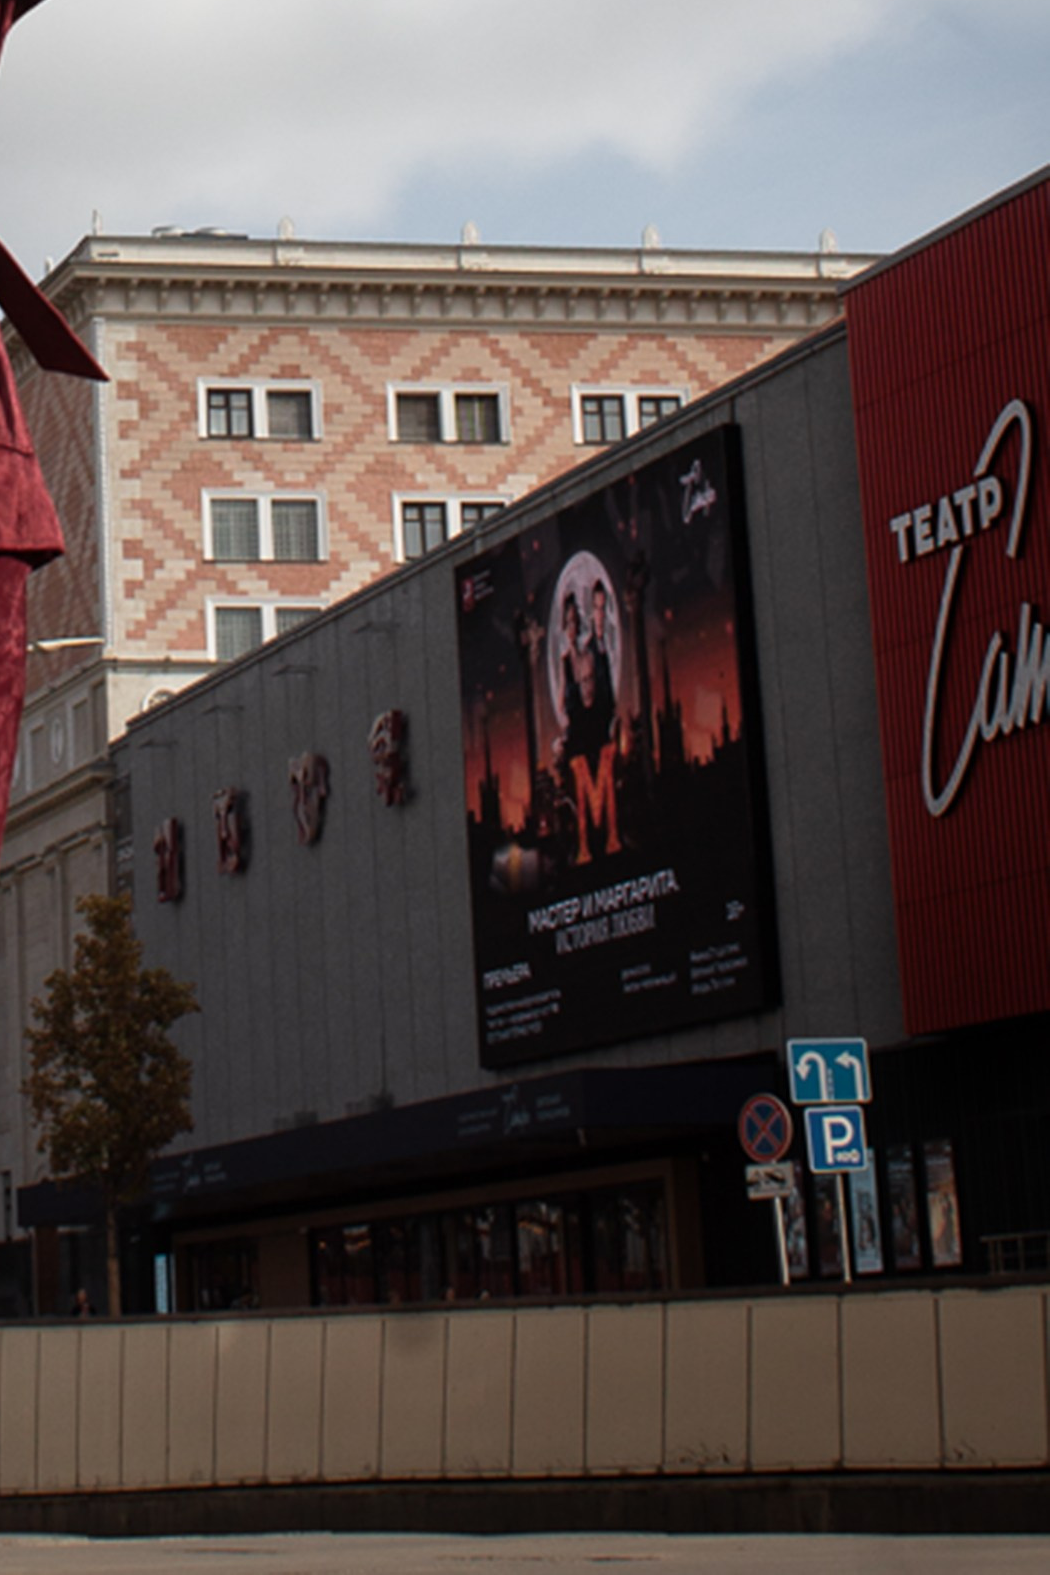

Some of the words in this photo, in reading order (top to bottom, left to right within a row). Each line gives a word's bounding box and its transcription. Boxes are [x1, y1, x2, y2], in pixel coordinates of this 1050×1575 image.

[890, 475, 1003, 563] ТЕАТР
[527, 897, 580, 935] МАСТЕР
[582, 891, 594, 919] И
